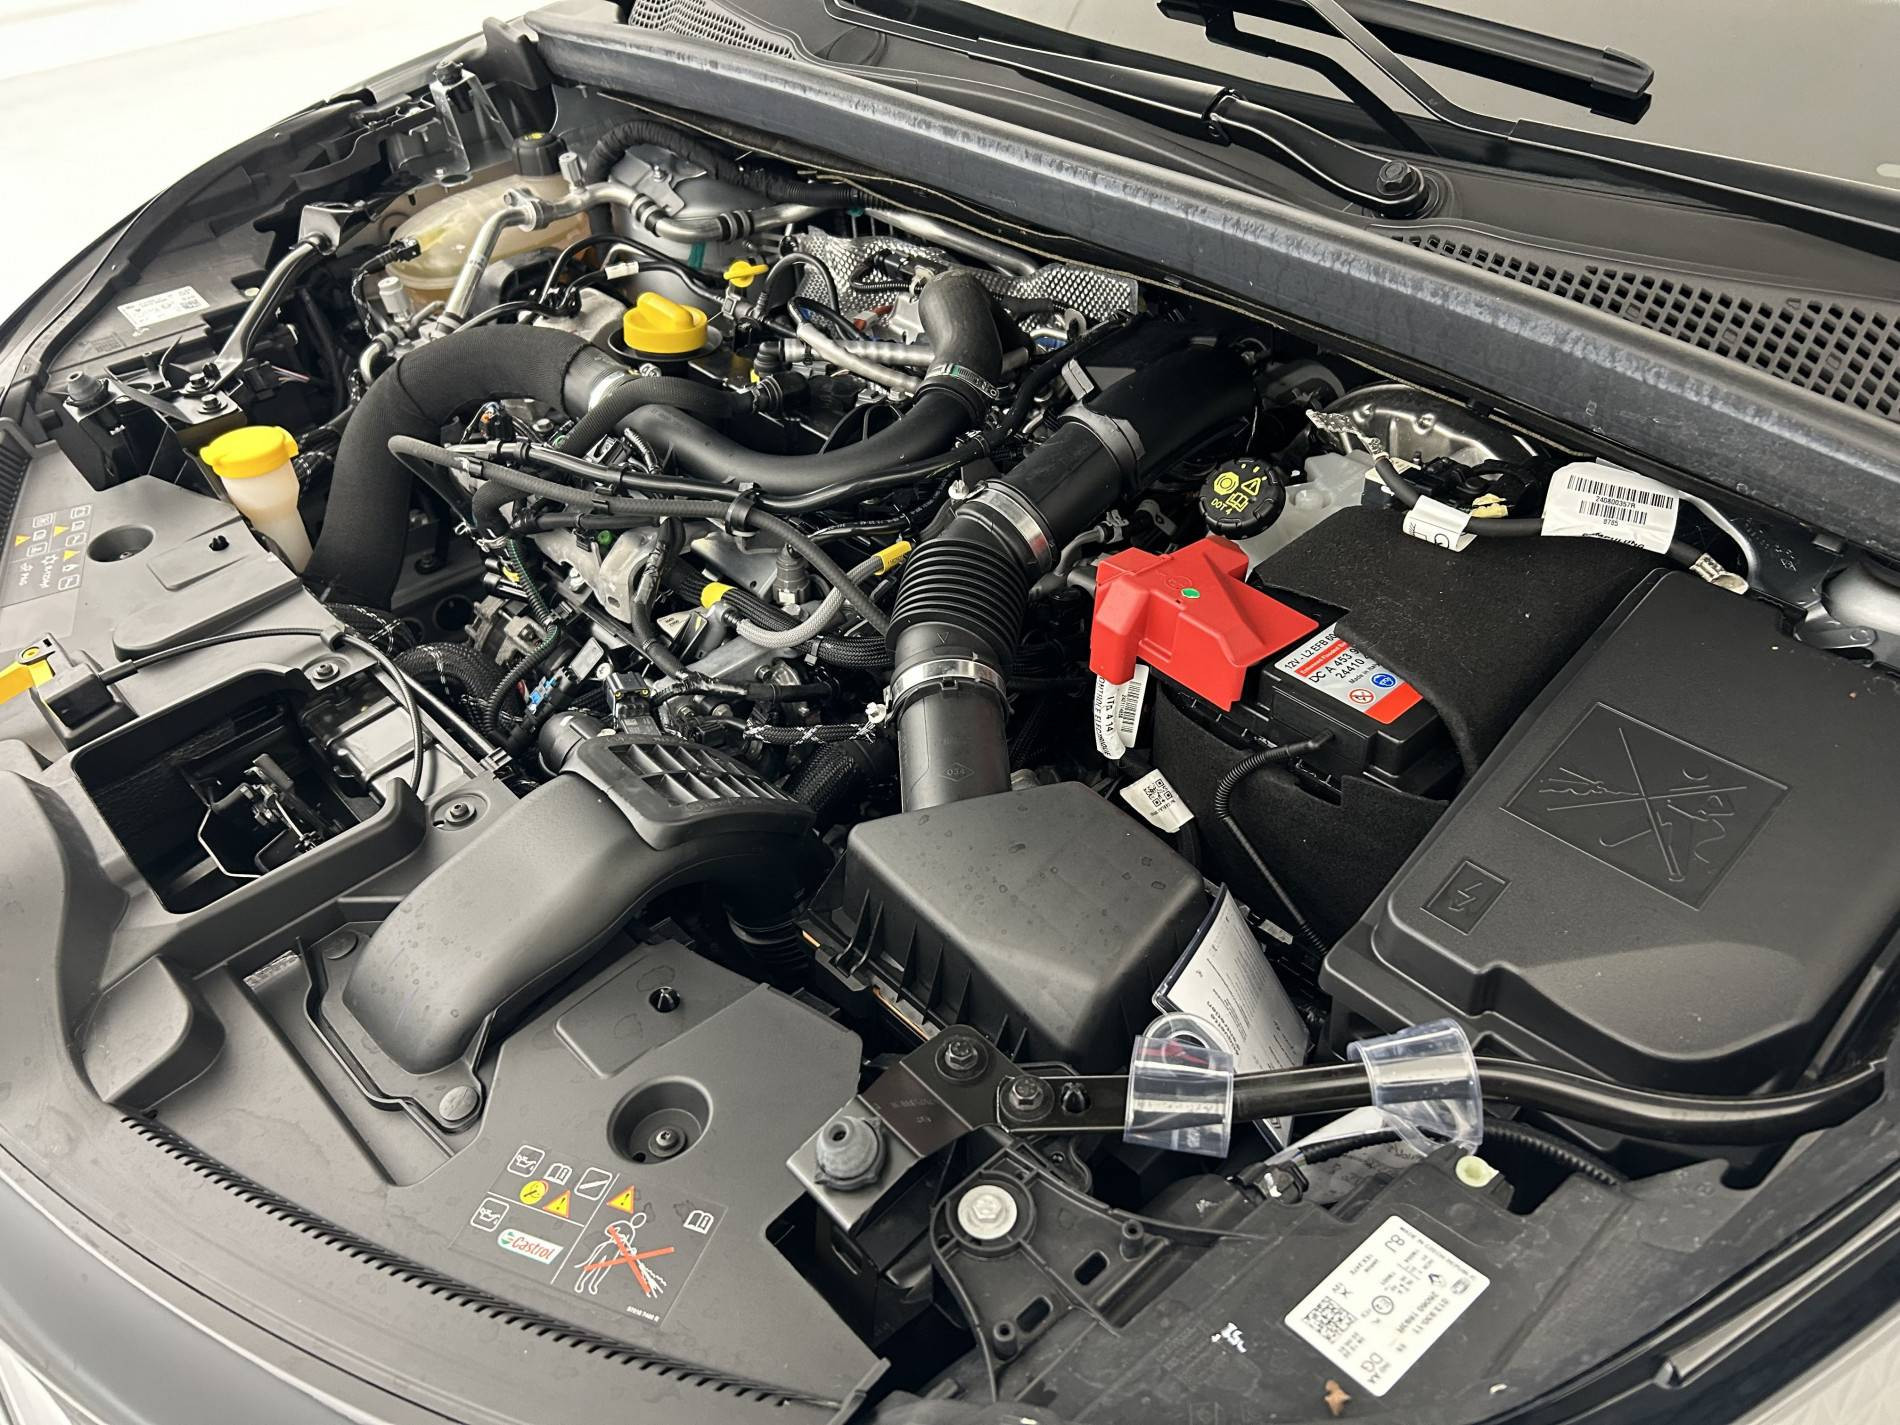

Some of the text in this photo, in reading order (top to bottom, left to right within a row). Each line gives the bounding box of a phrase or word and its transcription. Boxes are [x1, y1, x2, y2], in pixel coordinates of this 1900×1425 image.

[1211, 498, 1227, 511] DOT
[1284, 658, 1300, 669] 12V
[1301, 649, 1314, 658] L2
[1310, 639, 1329, 651] EFB
[1308, 671, 1326, 683] DC
[1334, 653, 1352, 666] 453
[1335, 658, 1365, 679] 24410
[1348, 674, 1364, 684] Made
[1095, 676, 1105, 712] ONTROLE
[511, 1236, 556, 1260] Castrol
